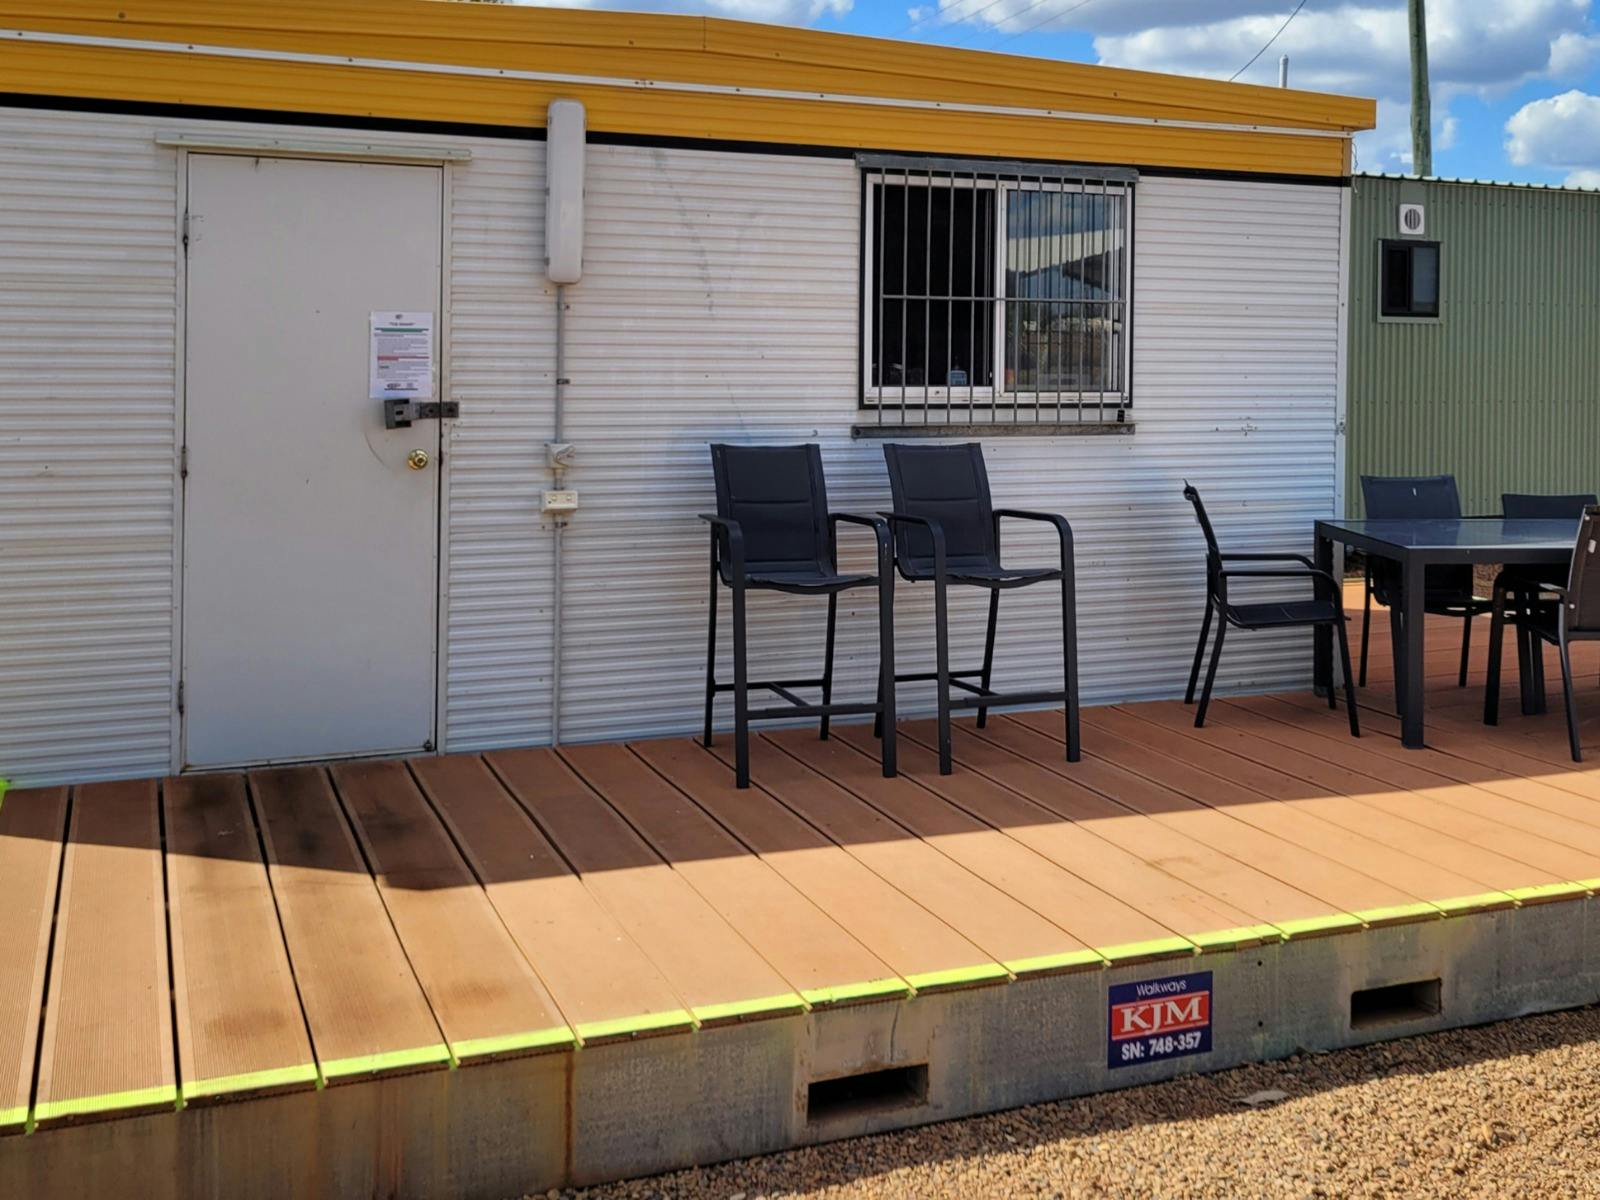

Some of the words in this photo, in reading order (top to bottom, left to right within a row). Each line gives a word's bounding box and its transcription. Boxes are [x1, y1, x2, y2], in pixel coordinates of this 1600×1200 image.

[1136, 979, 1187, 996] Walkways
[1121, 996, 1203, 1035] KJM
[1121, 1041, 1145, 1060] SN:
[1149, 1030, 1202, 1056] 748-357
